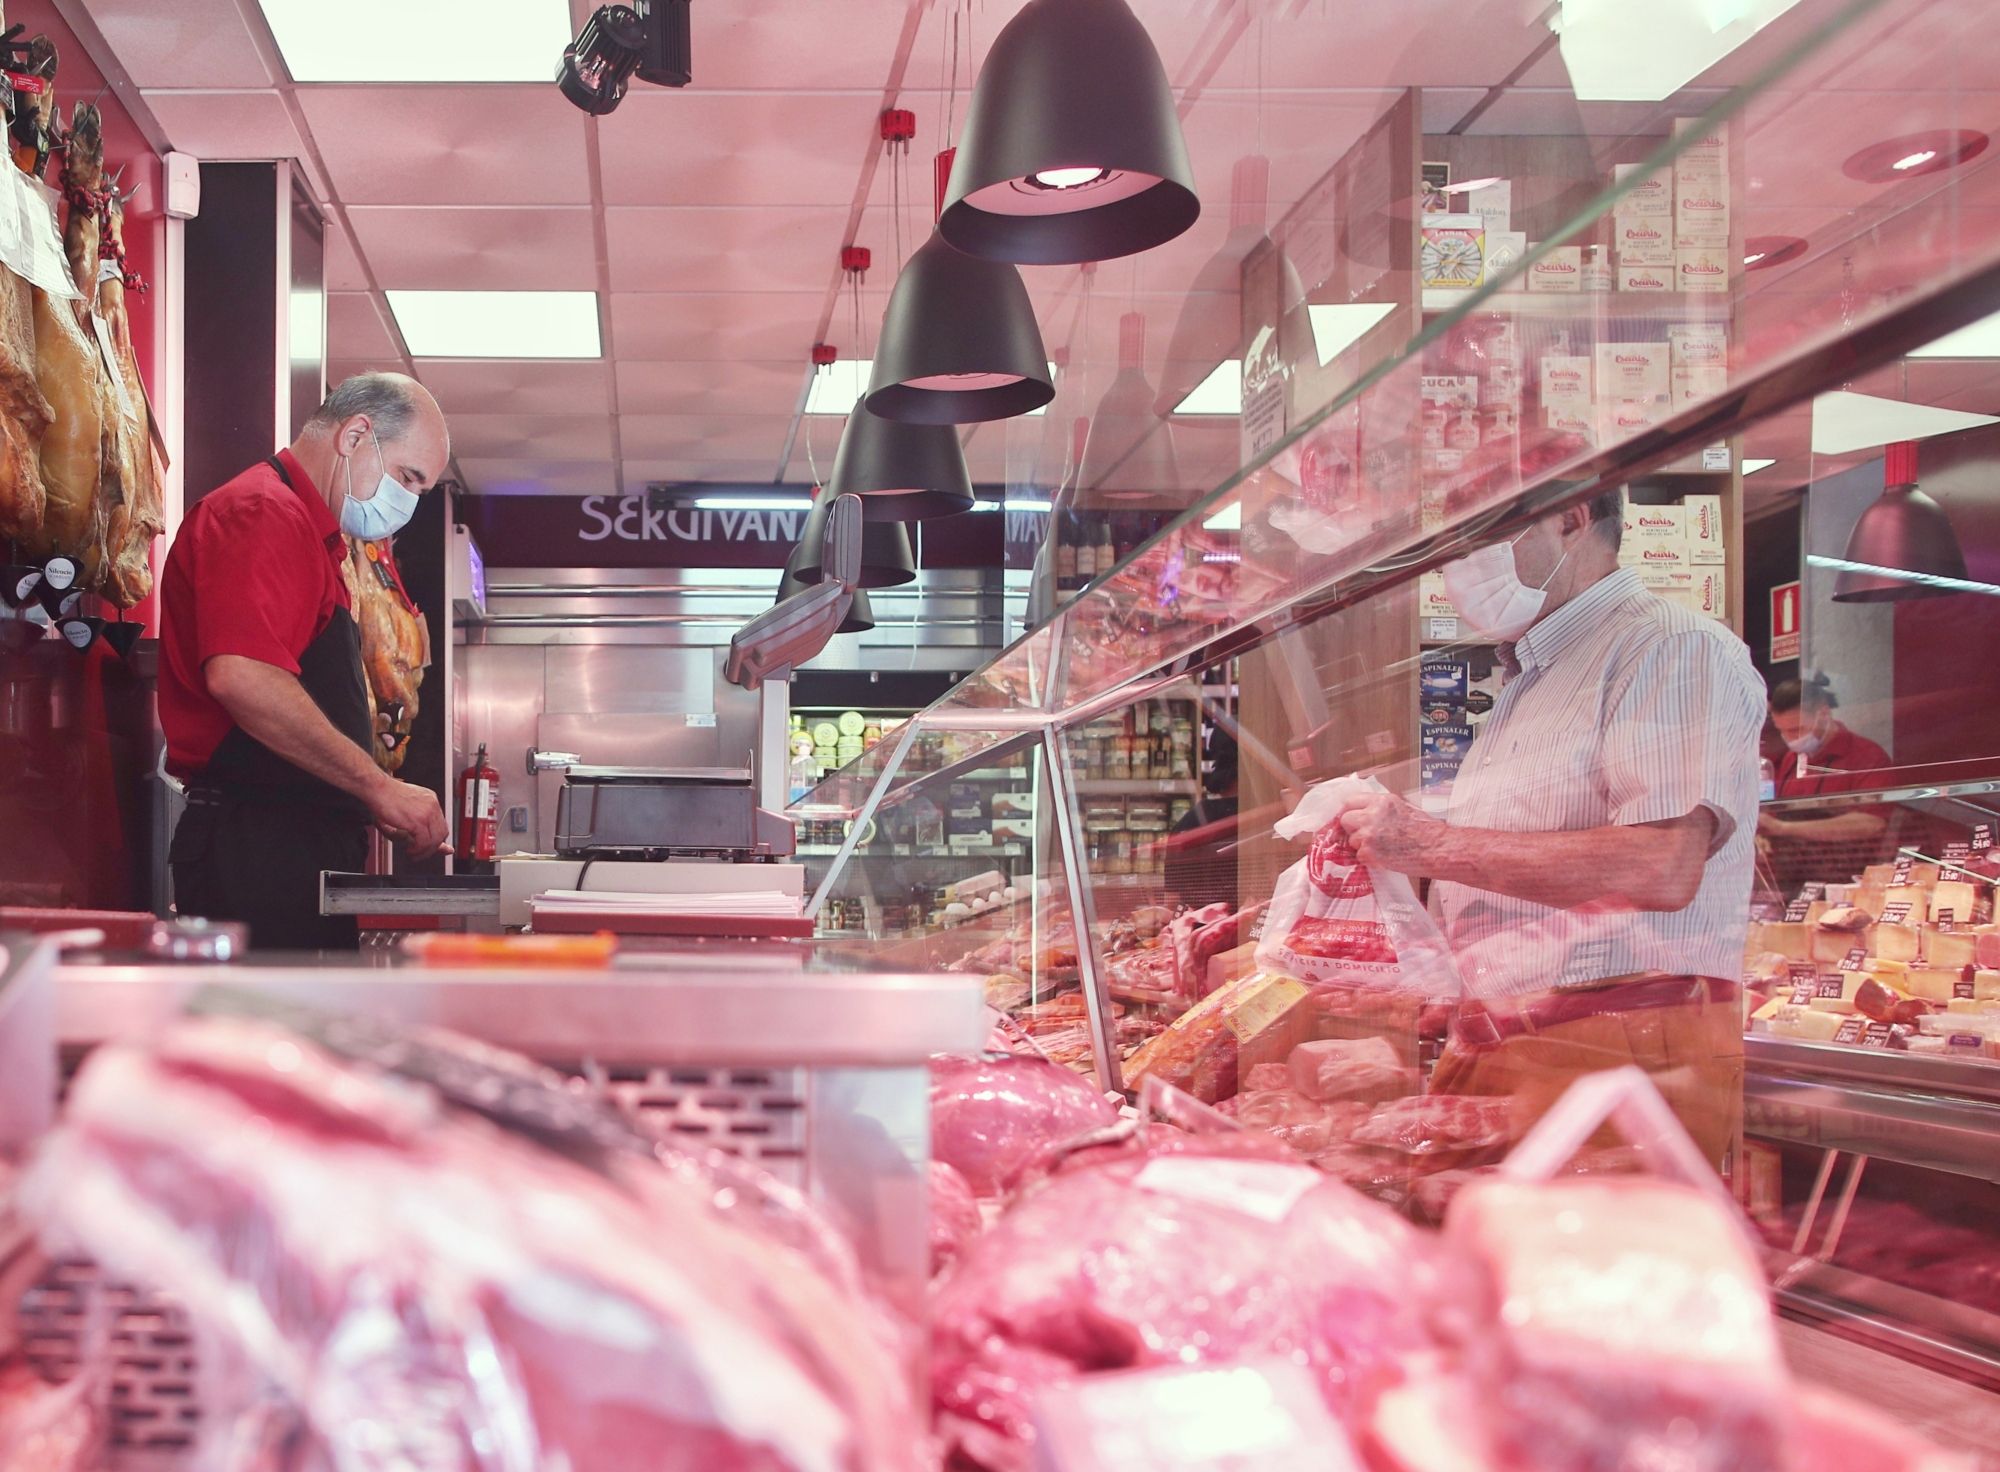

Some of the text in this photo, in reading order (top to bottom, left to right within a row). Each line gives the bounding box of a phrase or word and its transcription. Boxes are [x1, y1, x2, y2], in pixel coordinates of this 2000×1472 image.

[1682, 263, 1724, 276] Escuris
[1629, 278, 1664, 288] Escuris
[1639, 517, 1675, 528] Escuris
[1700, 504, 1710, 539] Escuris
[1643, 550, 1679, 560] Escuris
[1703, 575, 1713, 611] Escuris
[1426, 726, 1469, 737] ESPINALER
[1322, 961, 1330, 969] A
